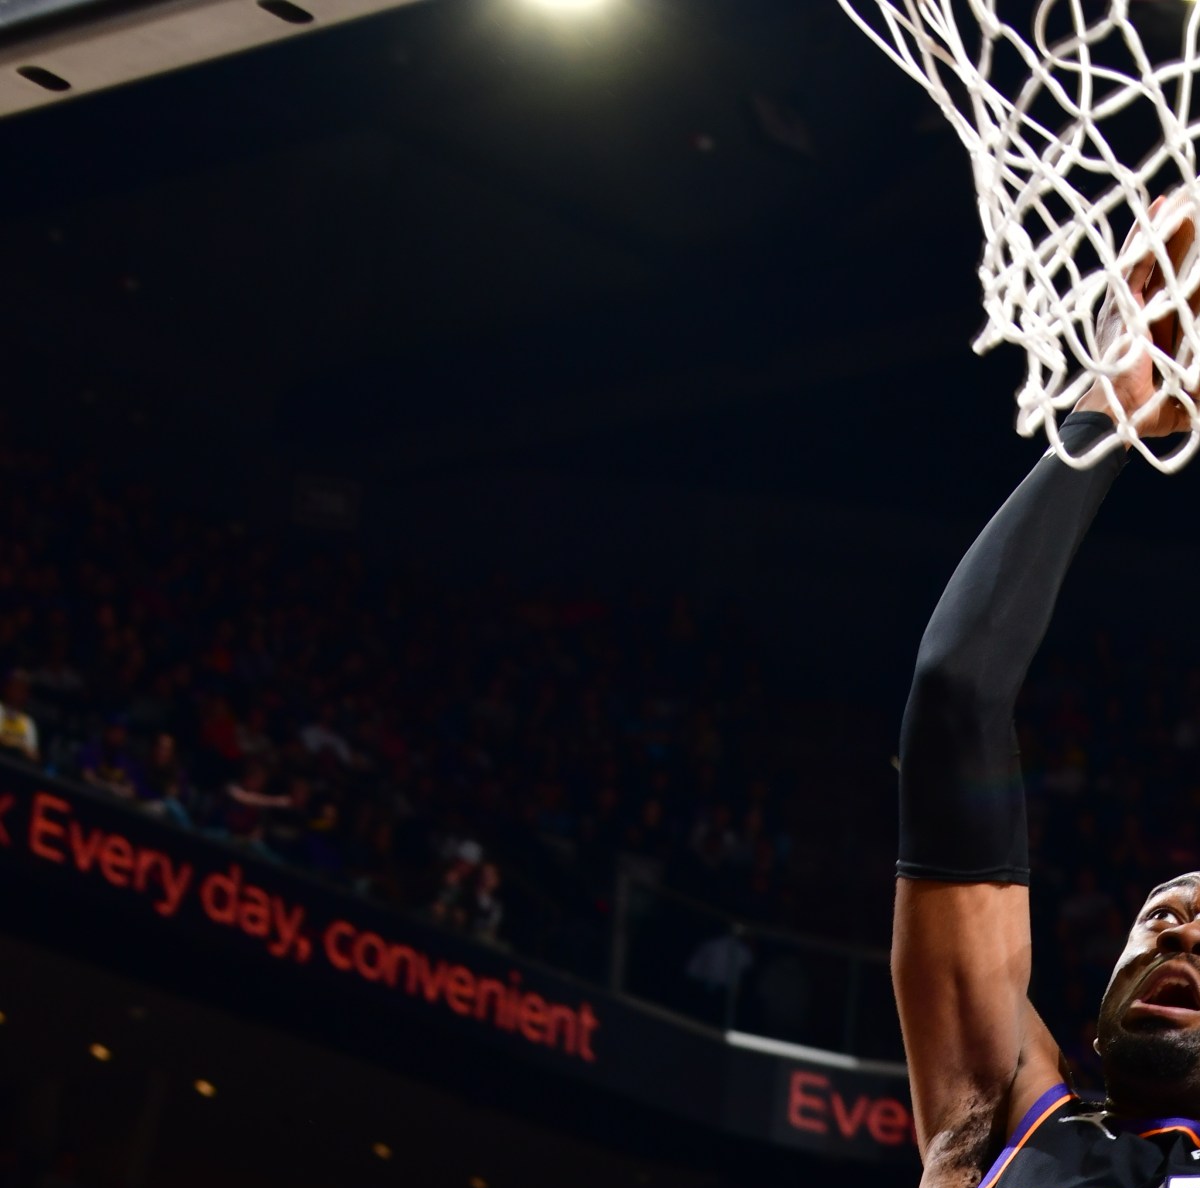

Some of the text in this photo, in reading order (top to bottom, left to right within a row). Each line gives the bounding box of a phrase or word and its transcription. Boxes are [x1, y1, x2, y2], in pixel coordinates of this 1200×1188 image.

[28, 791, 194, 917] Every
[201, 860, 312, 968] day,
[322, 918, 599, 1063] convenient
[786, 1068, 918, 1147] Eve
